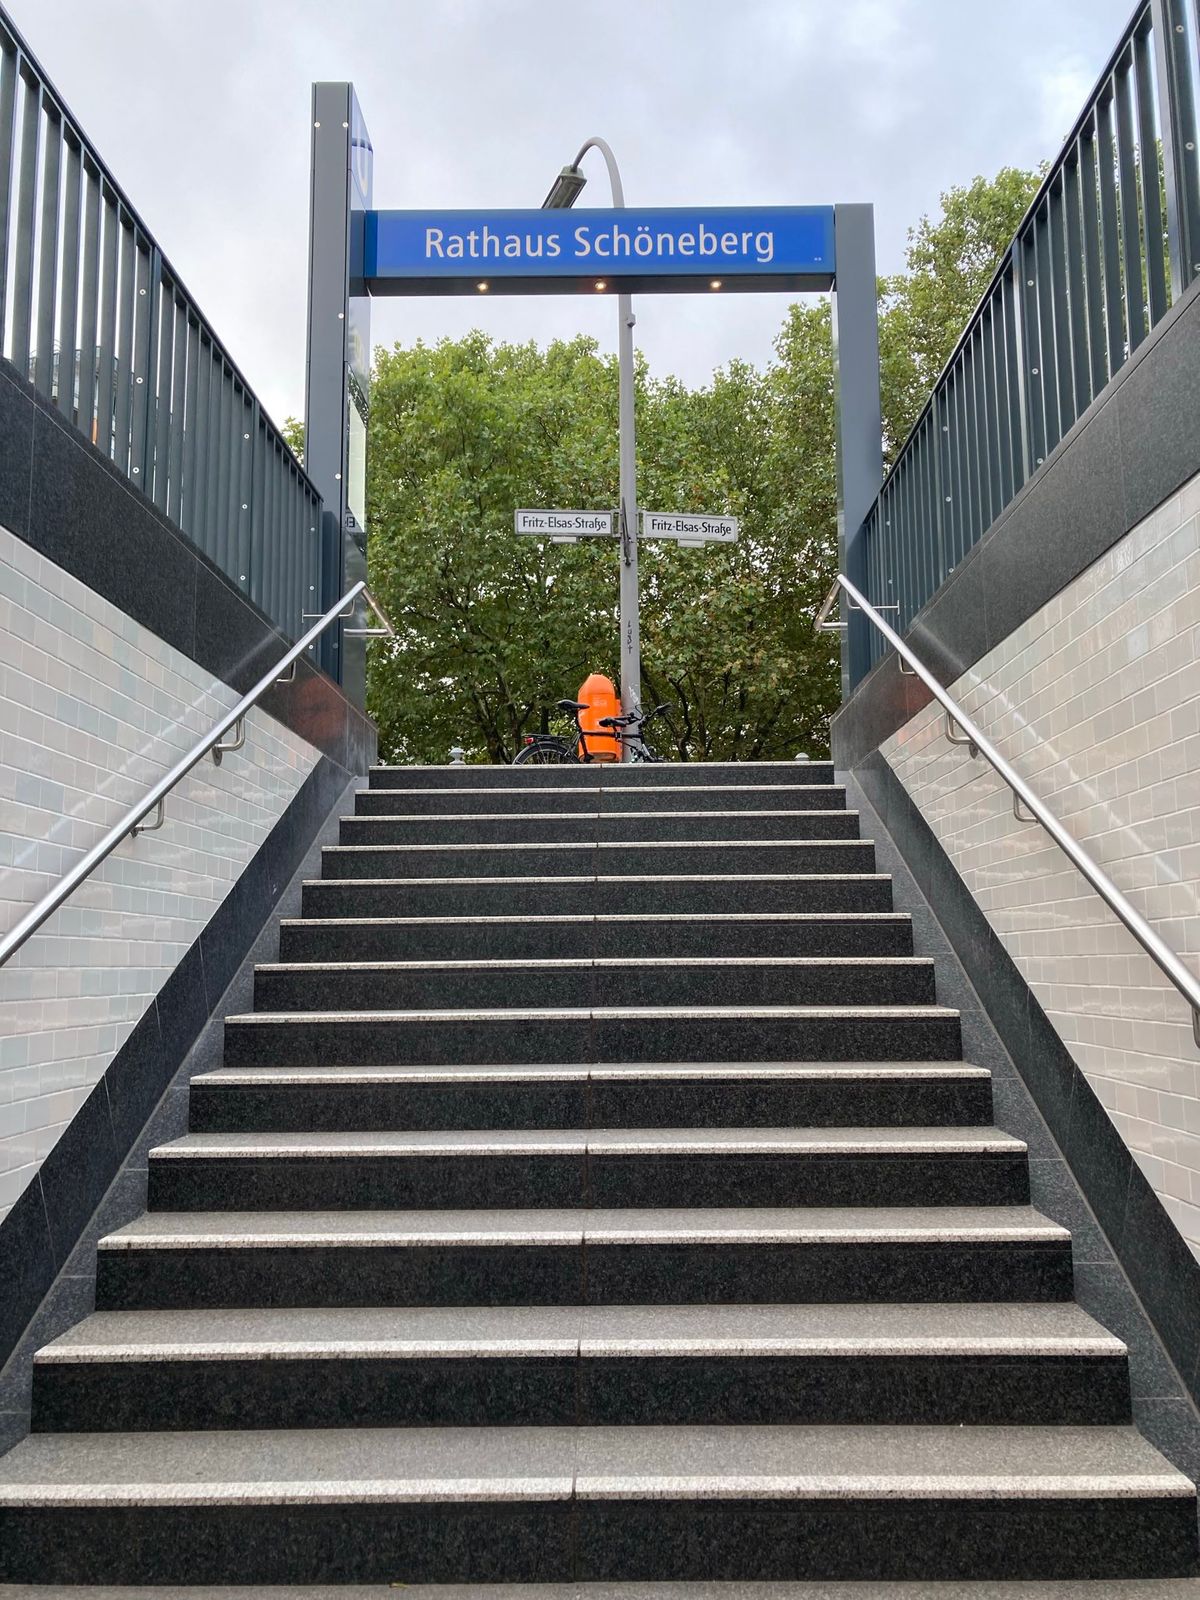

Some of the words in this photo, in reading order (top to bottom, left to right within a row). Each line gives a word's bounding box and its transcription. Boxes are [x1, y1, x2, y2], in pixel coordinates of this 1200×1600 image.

[425, 226, 561, 258] Rathaus
[574, 224, 775, 263] Schöneberg
[522, 516, 608, 532] Fritz-Elsas-Straße
[651, 518, 732, 537] Fritz-Elsas-Straße
